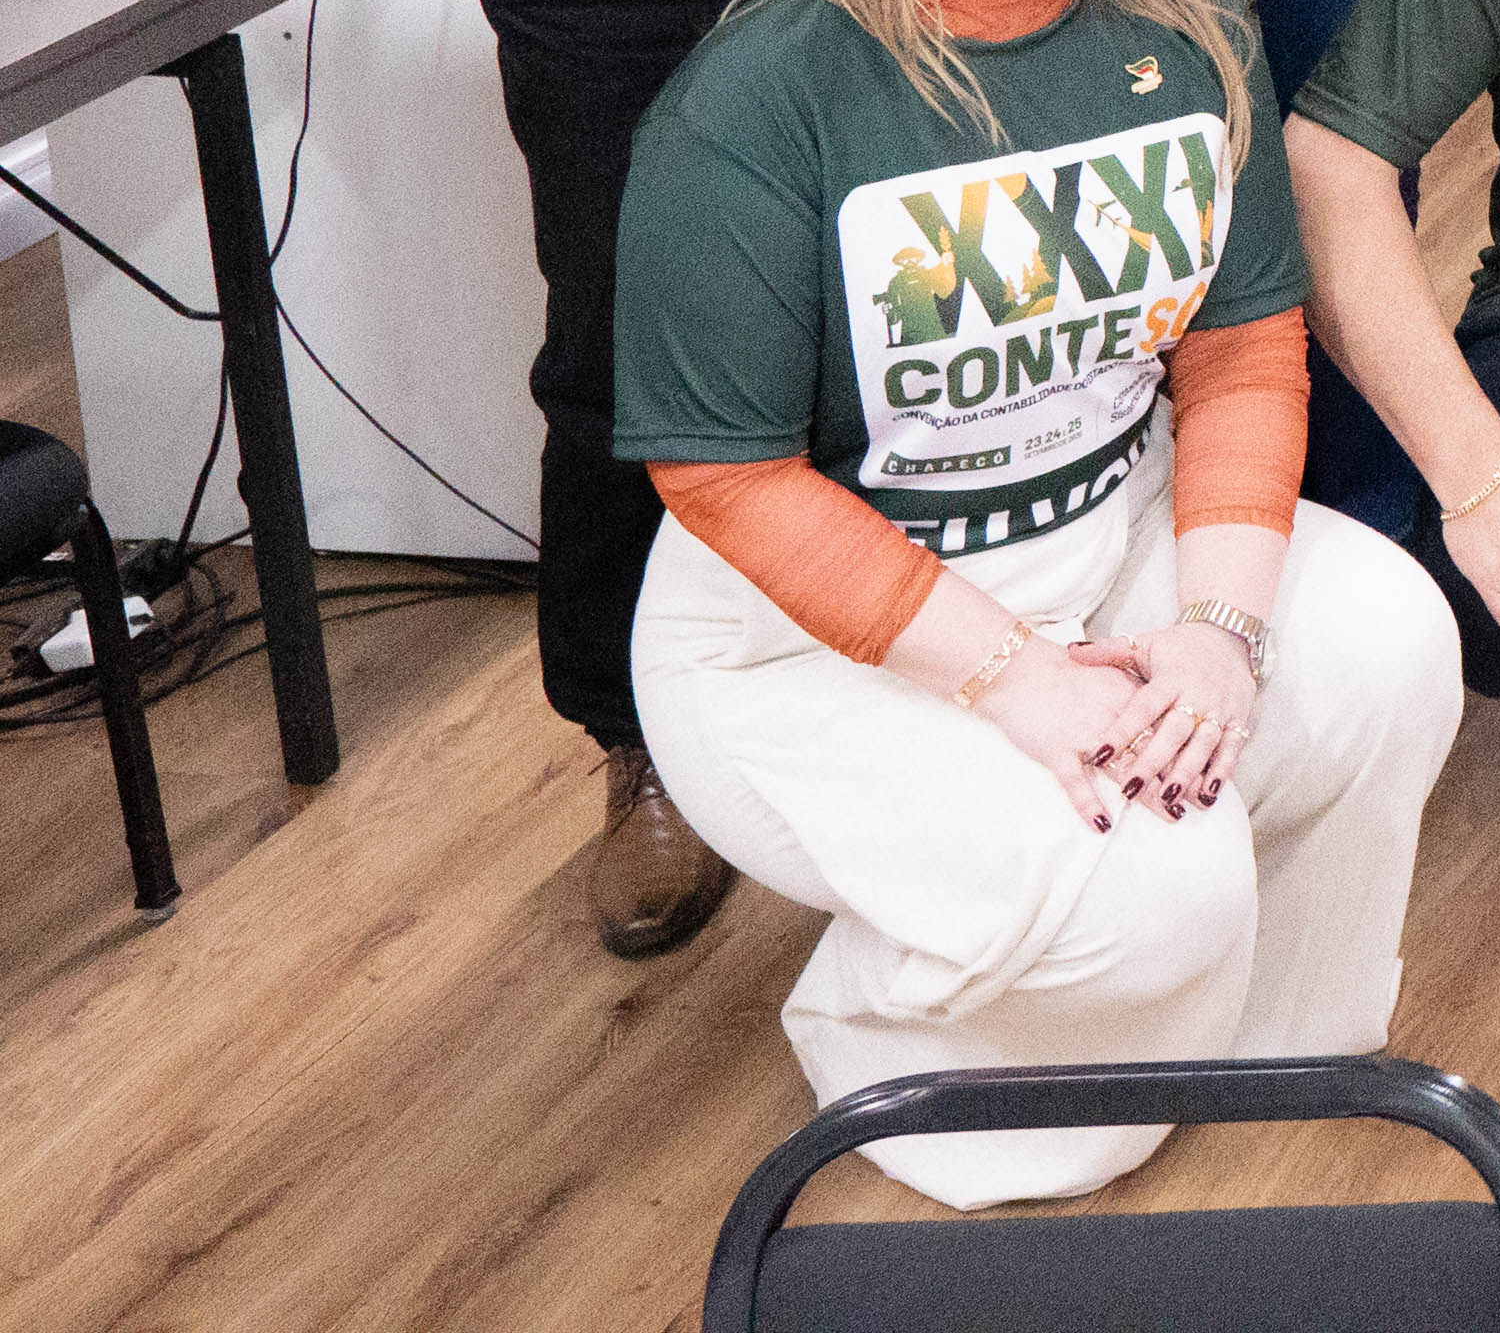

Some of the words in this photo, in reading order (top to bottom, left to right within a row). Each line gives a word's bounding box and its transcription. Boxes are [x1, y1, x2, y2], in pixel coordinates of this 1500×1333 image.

[886, 132, 1216, 348] XXXI
[962, 411, 979, 424] DA
[980, 383, 1072, 419] CONTABILIDADE
[887, 451, 1005, 473] CHAPECÓ
[1025, 436, 1042, 450] 23
[1044, 429, 1061, 444] 24
[1067, 417, 1082, 431] 25
